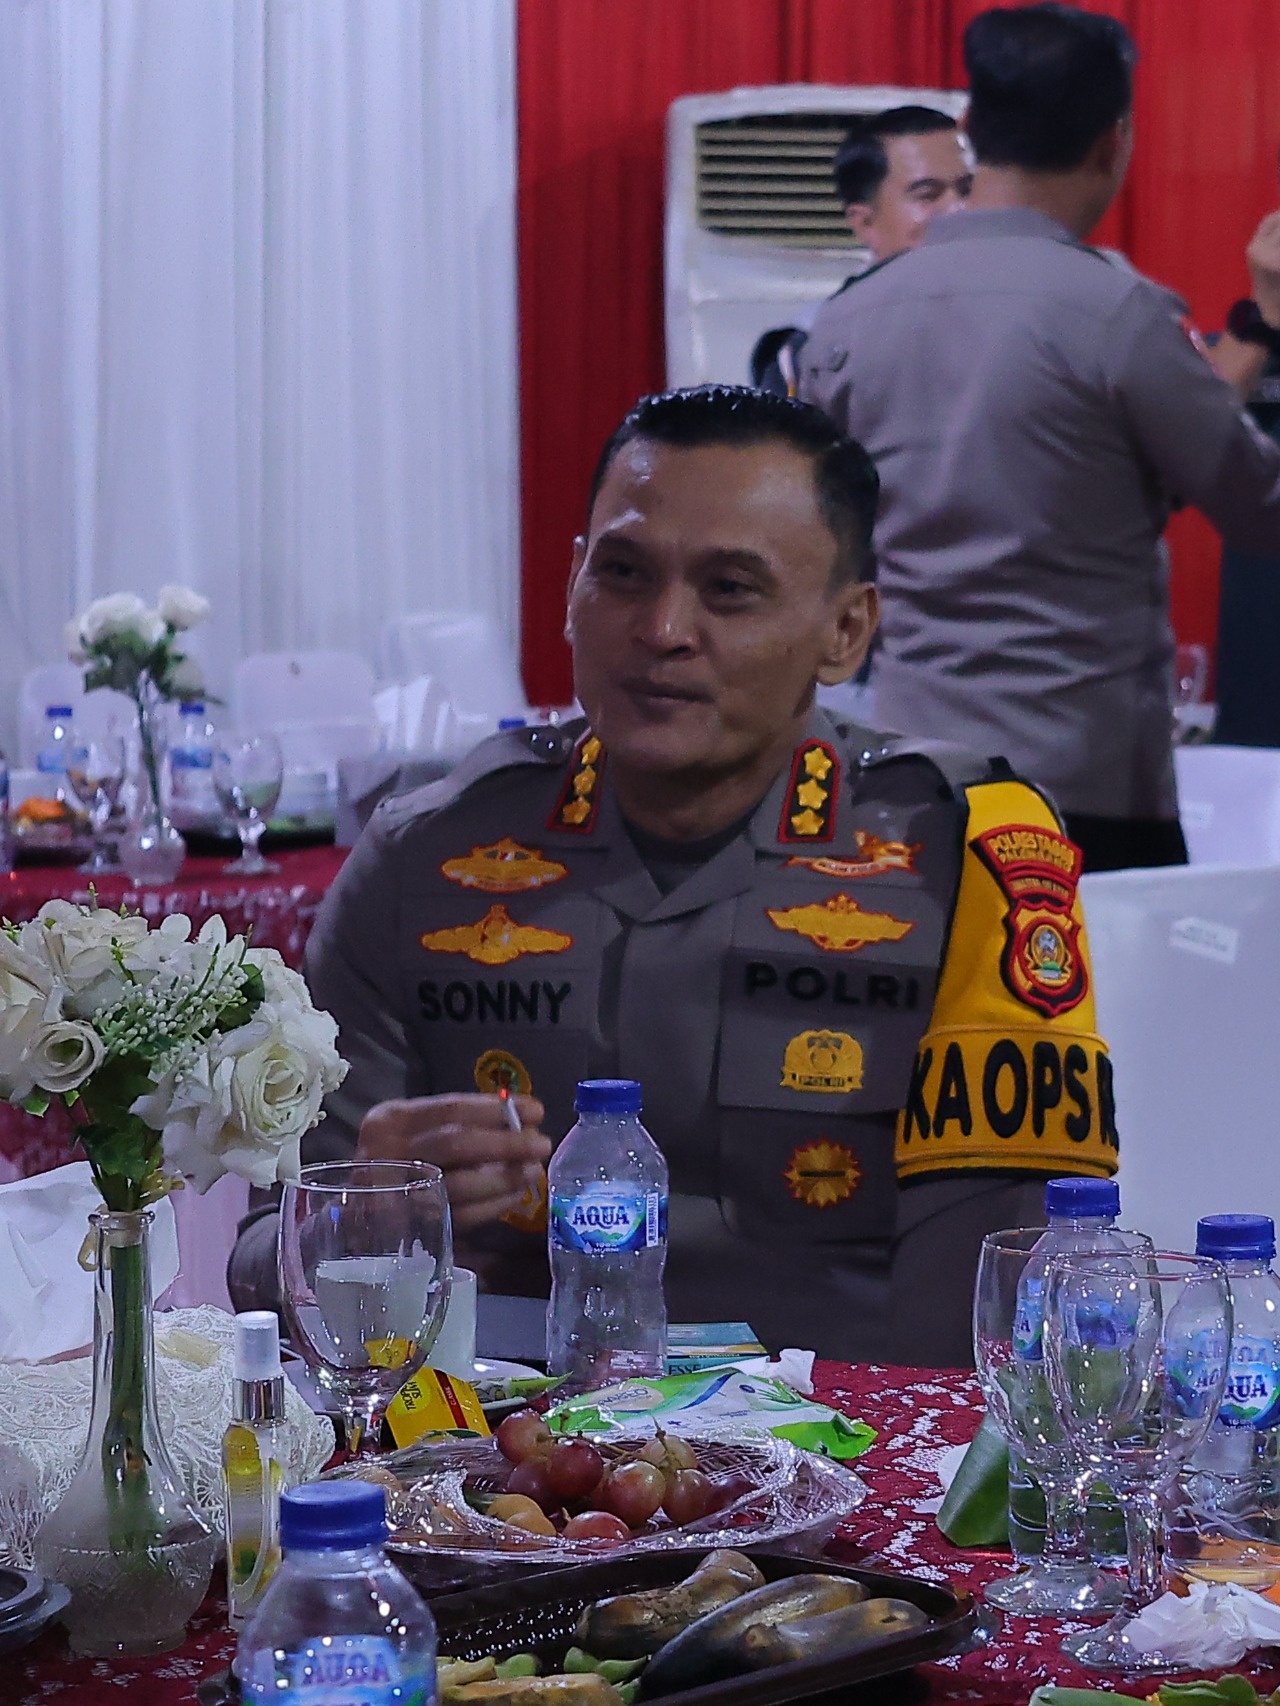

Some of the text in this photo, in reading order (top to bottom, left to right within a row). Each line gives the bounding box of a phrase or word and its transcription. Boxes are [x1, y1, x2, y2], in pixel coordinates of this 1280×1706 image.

[418, 980, 572, 1024] SONNY
[745, 962, 918, 1010] POLRI
[572, 1205, 630, 1230] AQUA
